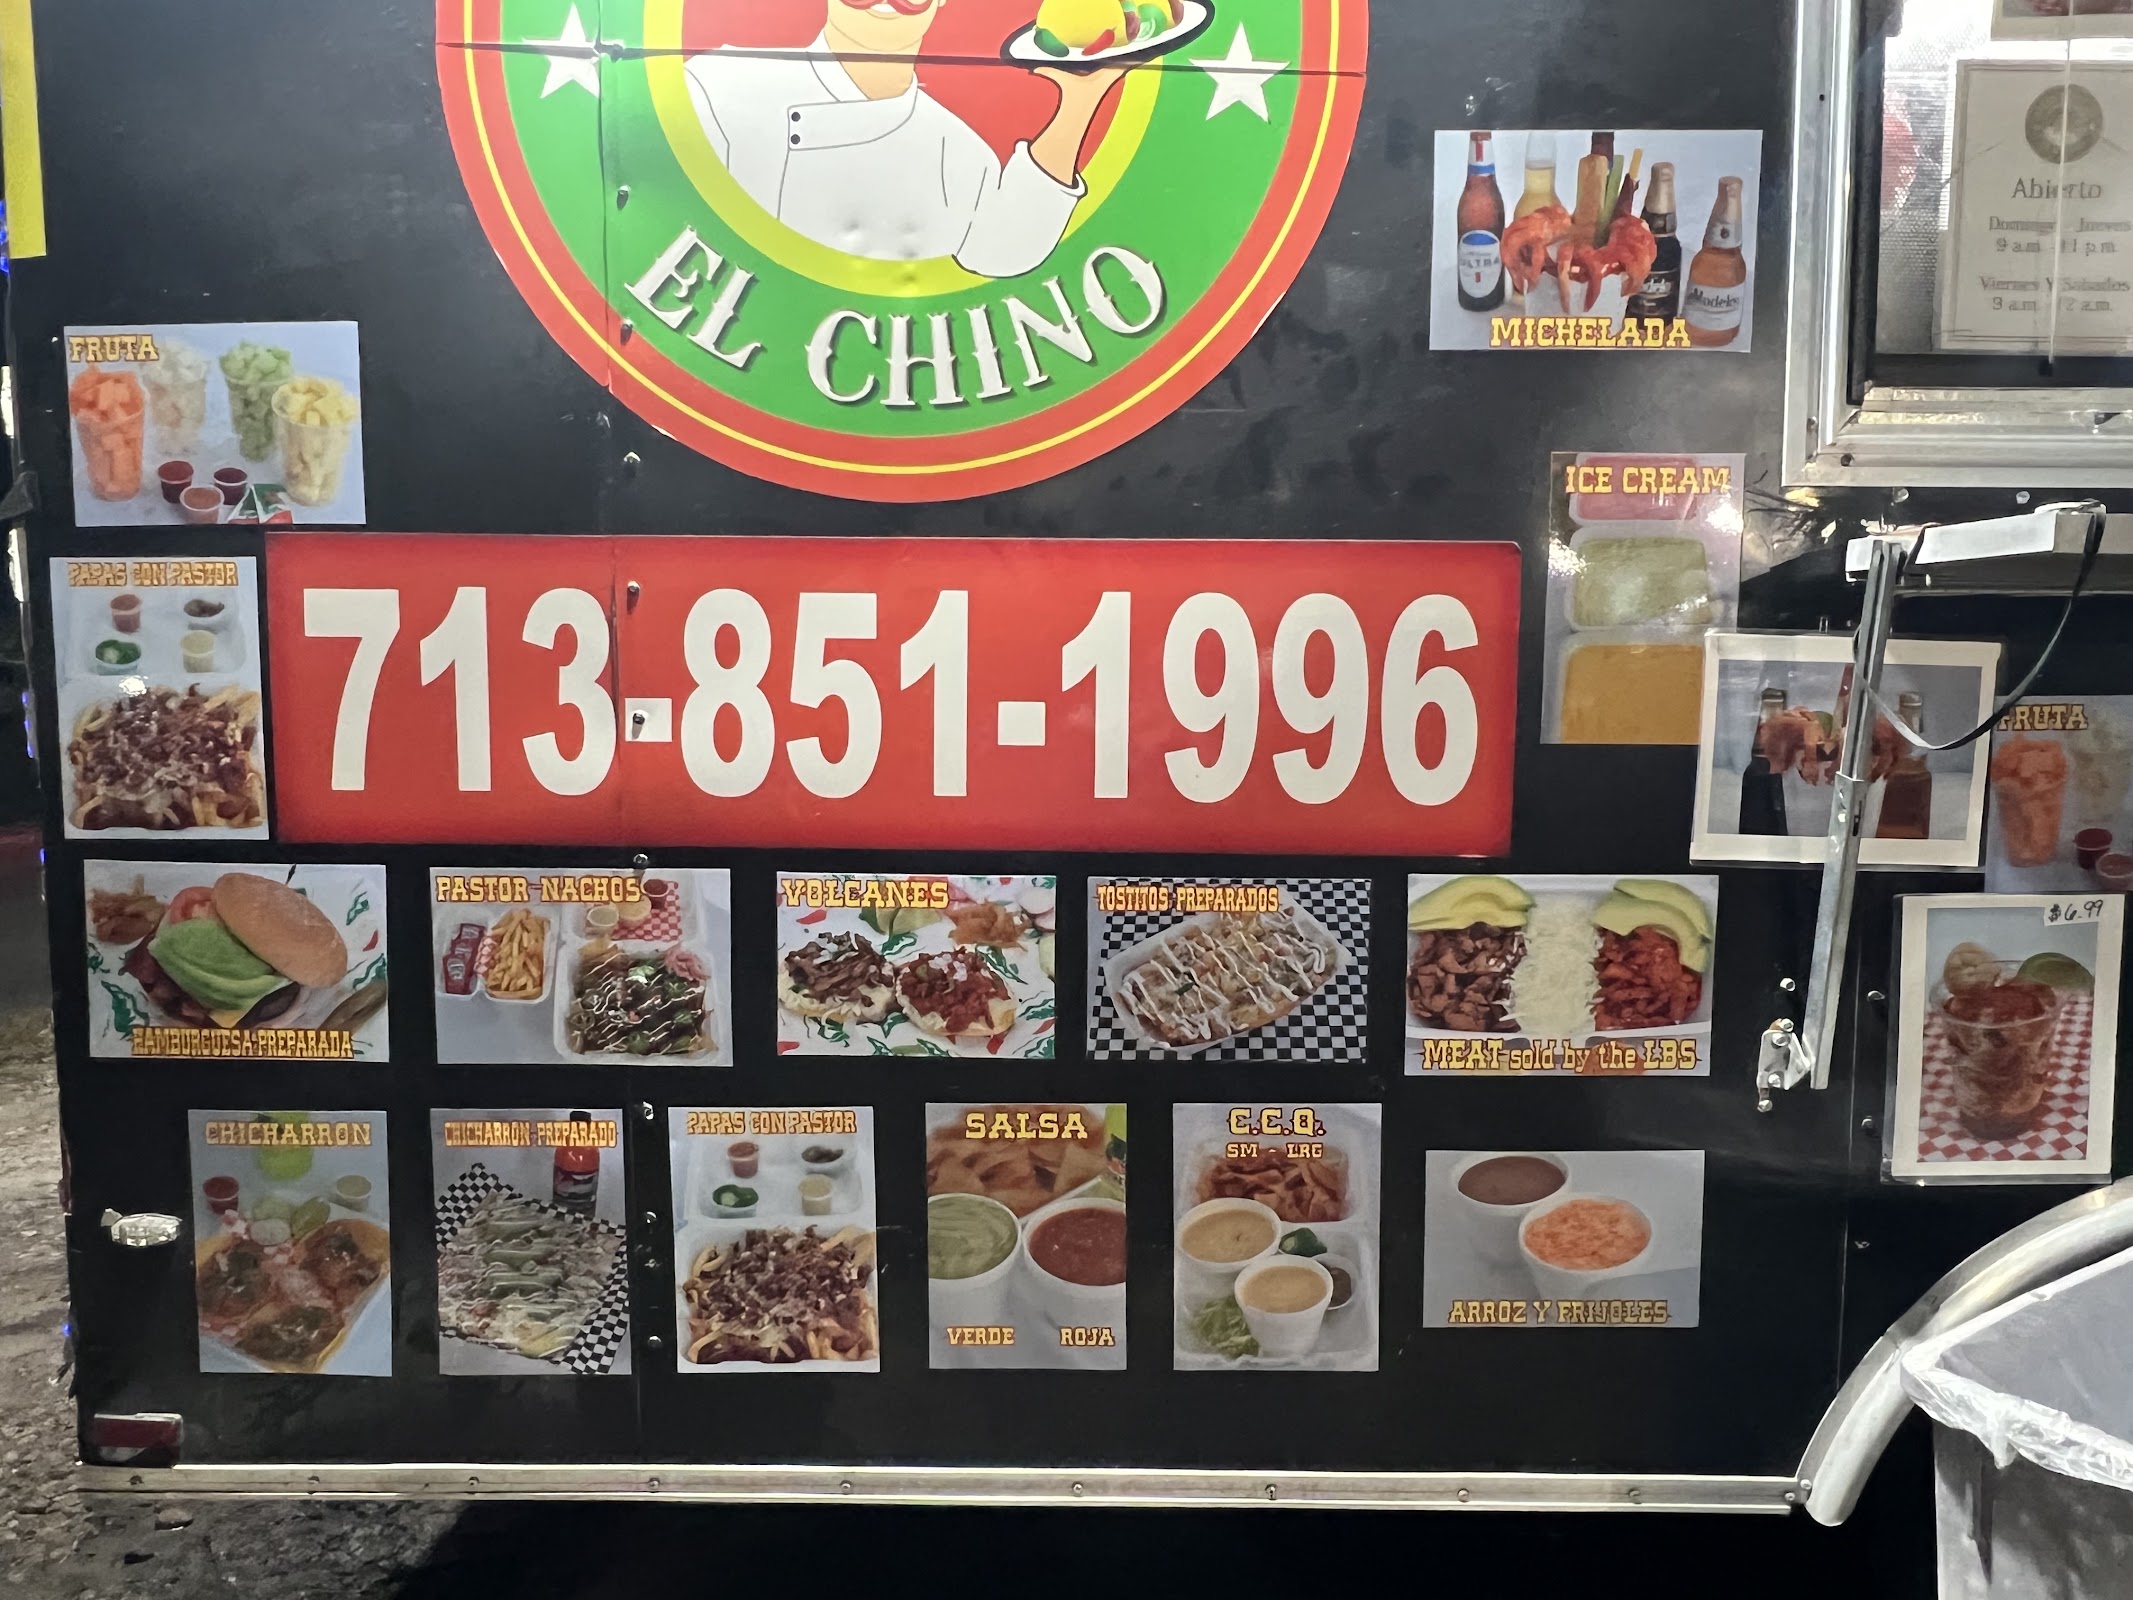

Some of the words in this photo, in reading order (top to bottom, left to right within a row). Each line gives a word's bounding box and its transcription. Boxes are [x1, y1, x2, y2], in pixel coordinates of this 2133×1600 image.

[623, 224, 766, 372] EL
[805, 246, 1165, 406] CHINO
[1490, 316, 1692, 348] MICHELADA
[68, 334, 160, 363] FRUTA
[1565, 465, 1613, 494] ICE
[1622, 464, 1732, 495] CREAM
[67, 561, 127, 587] PAPAS
[132, 561, 168, 587] CON
[168, 561, 239, 587] PASTOR
[303, 586, 1480, 806] 713-851-1996
[780, 878, 950, 909] VOLCANES
[1097, 885, 1170, 912] TOSTITOS
[1176, 885, 1280, 913] PREPARADOS
[1421, 1038, 1503, 1070] MEAT
[1508, 1039, 1557, 1070] sold
[1562, 1039, 1590, 1074] by
[1598, 1040, 1636, 1070] the
[1642, 1039, 1697, 1070] LBS
[205, 1120, 372, 1146] CHICHARRON
[686, 1111, 746, 1135] PAPAS
[749, 1111, 786, 1135] CON
[787, 1110, 858, 1134] PASTOR
[965, 1112, 1088, 1140] SALSA
[1227, 1107, 1327, 1137] C.C.Q.
[1226, 1143, 1259, 1159] SM
[1285, 1143, 1324, 1159] LRG
[1448, 1300, 1528, 1325] ARROZ
[1531, 1300, 1552, 1325] Y
[1557, 1300, 1670, 1325] FRIJOLES
[946, 1326, 1016, 1346] VERDE
[1060, 1326, 1116, 1347] ROJA
